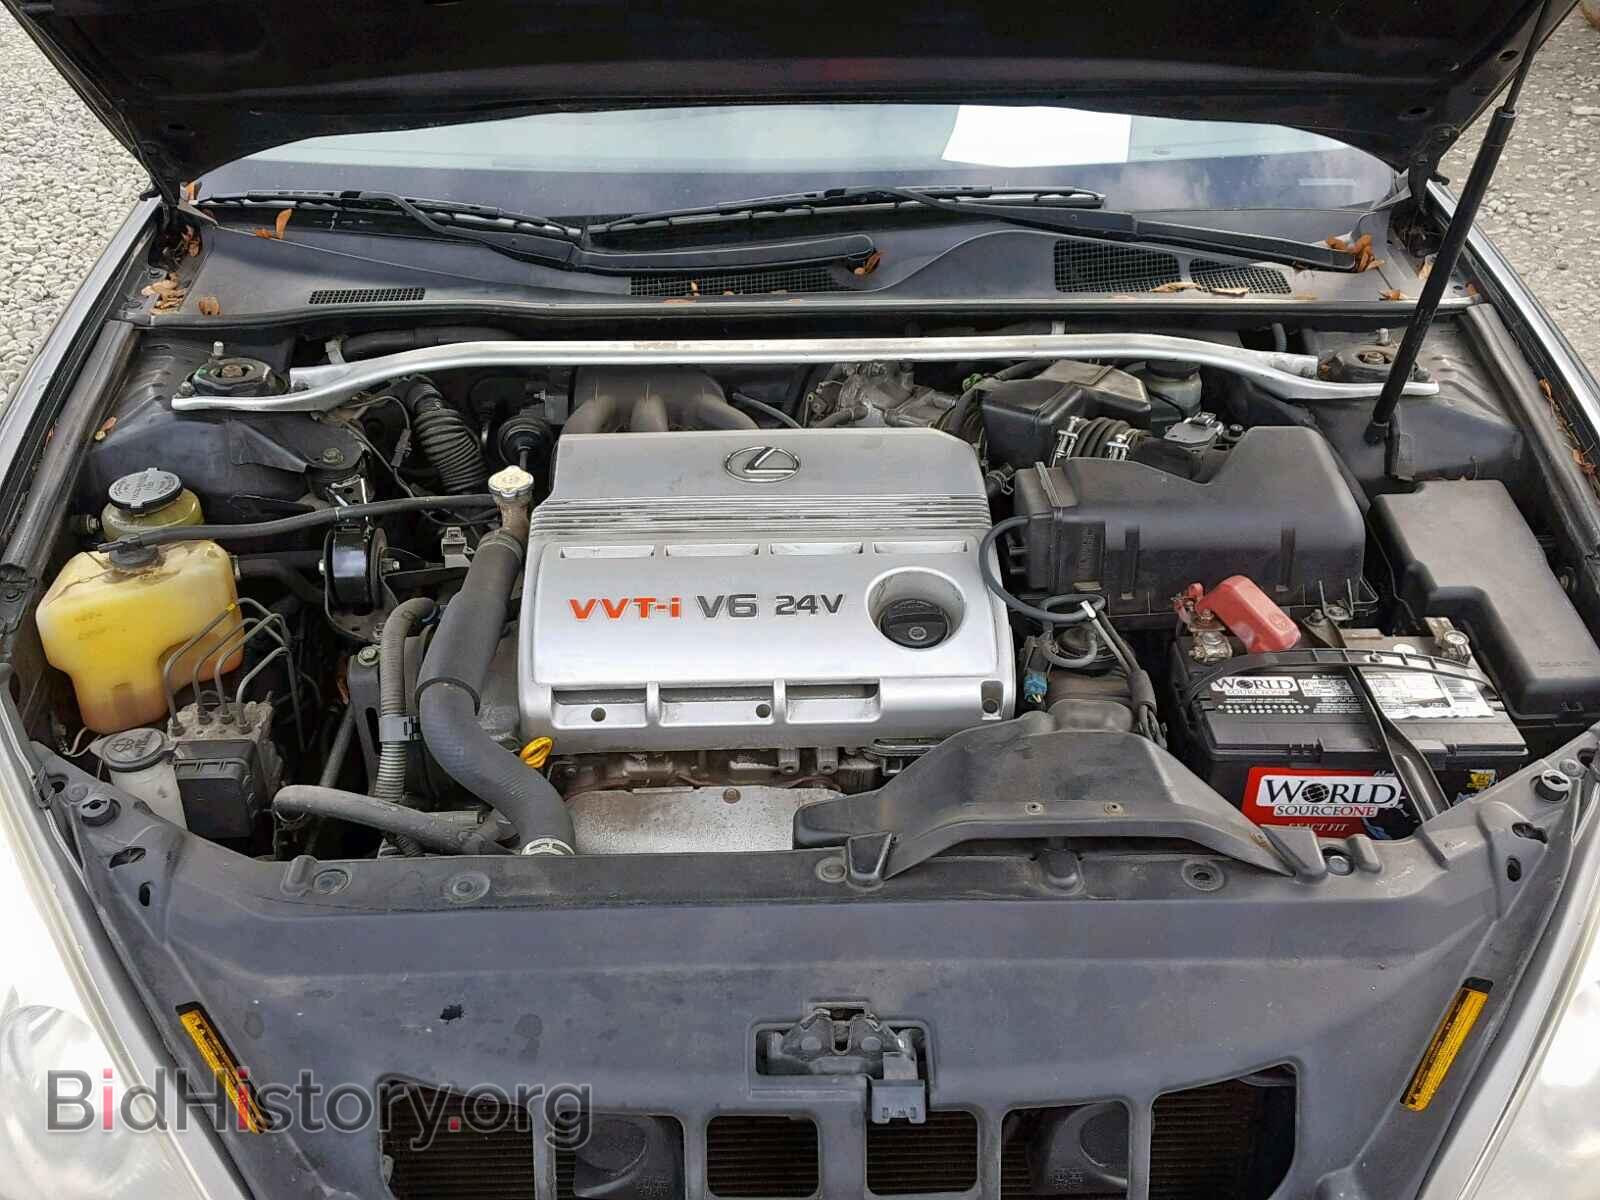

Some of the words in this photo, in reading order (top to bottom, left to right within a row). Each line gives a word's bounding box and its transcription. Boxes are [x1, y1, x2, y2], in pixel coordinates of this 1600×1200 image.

[568, 597, 682, 621] VVT-i
[696, 593, 759, 619] V6
[775, 593, 844, 616] 24V
[1264, 780, 1396, 804] WORLD
[1275, 805, 1376, 817] SOURCEONE
